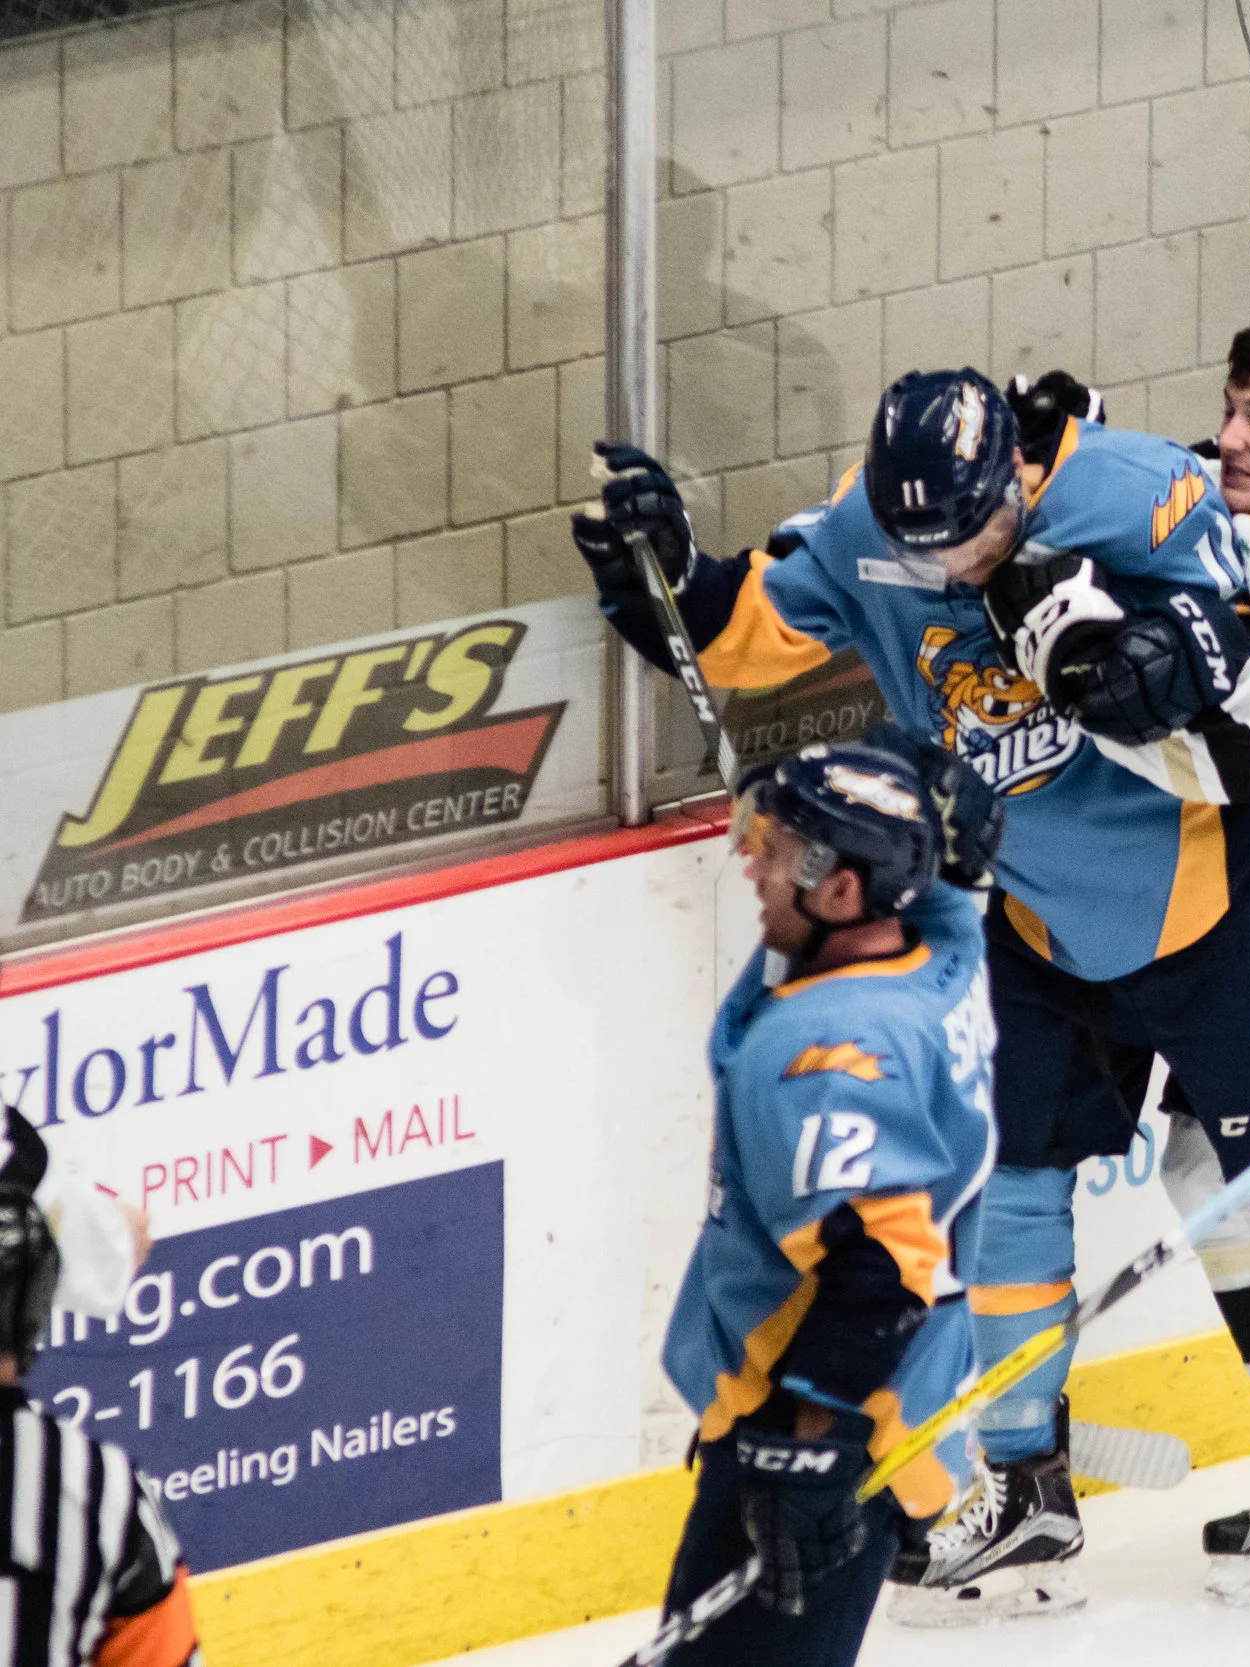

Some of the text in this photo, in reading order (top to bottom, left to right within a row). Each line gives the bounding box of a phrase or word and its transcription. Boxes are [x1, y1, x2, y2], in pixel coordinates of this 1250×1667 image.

[902, 479, 926, 508] 11
[1194, 511, 1246, 600] 11
[666, 634, 717, 723] CCM
[1169, 592, 1232, 692] CCM
[57, 625, 516, 848] JEFF'S
[732, 700, 874, 752] UTO BODY
[971, 713, 1082, 794] alley
[36, 784, 524, 911] AUTO BODY & COLLISION CENTER
[142, 1094, 476, 1213] PRINT MAIL
[791, 1110, 879, 1199] 12
[37, 1224, 374, 1347] ig.com
[150, 1404, 457, 1500] eeling Nailers
